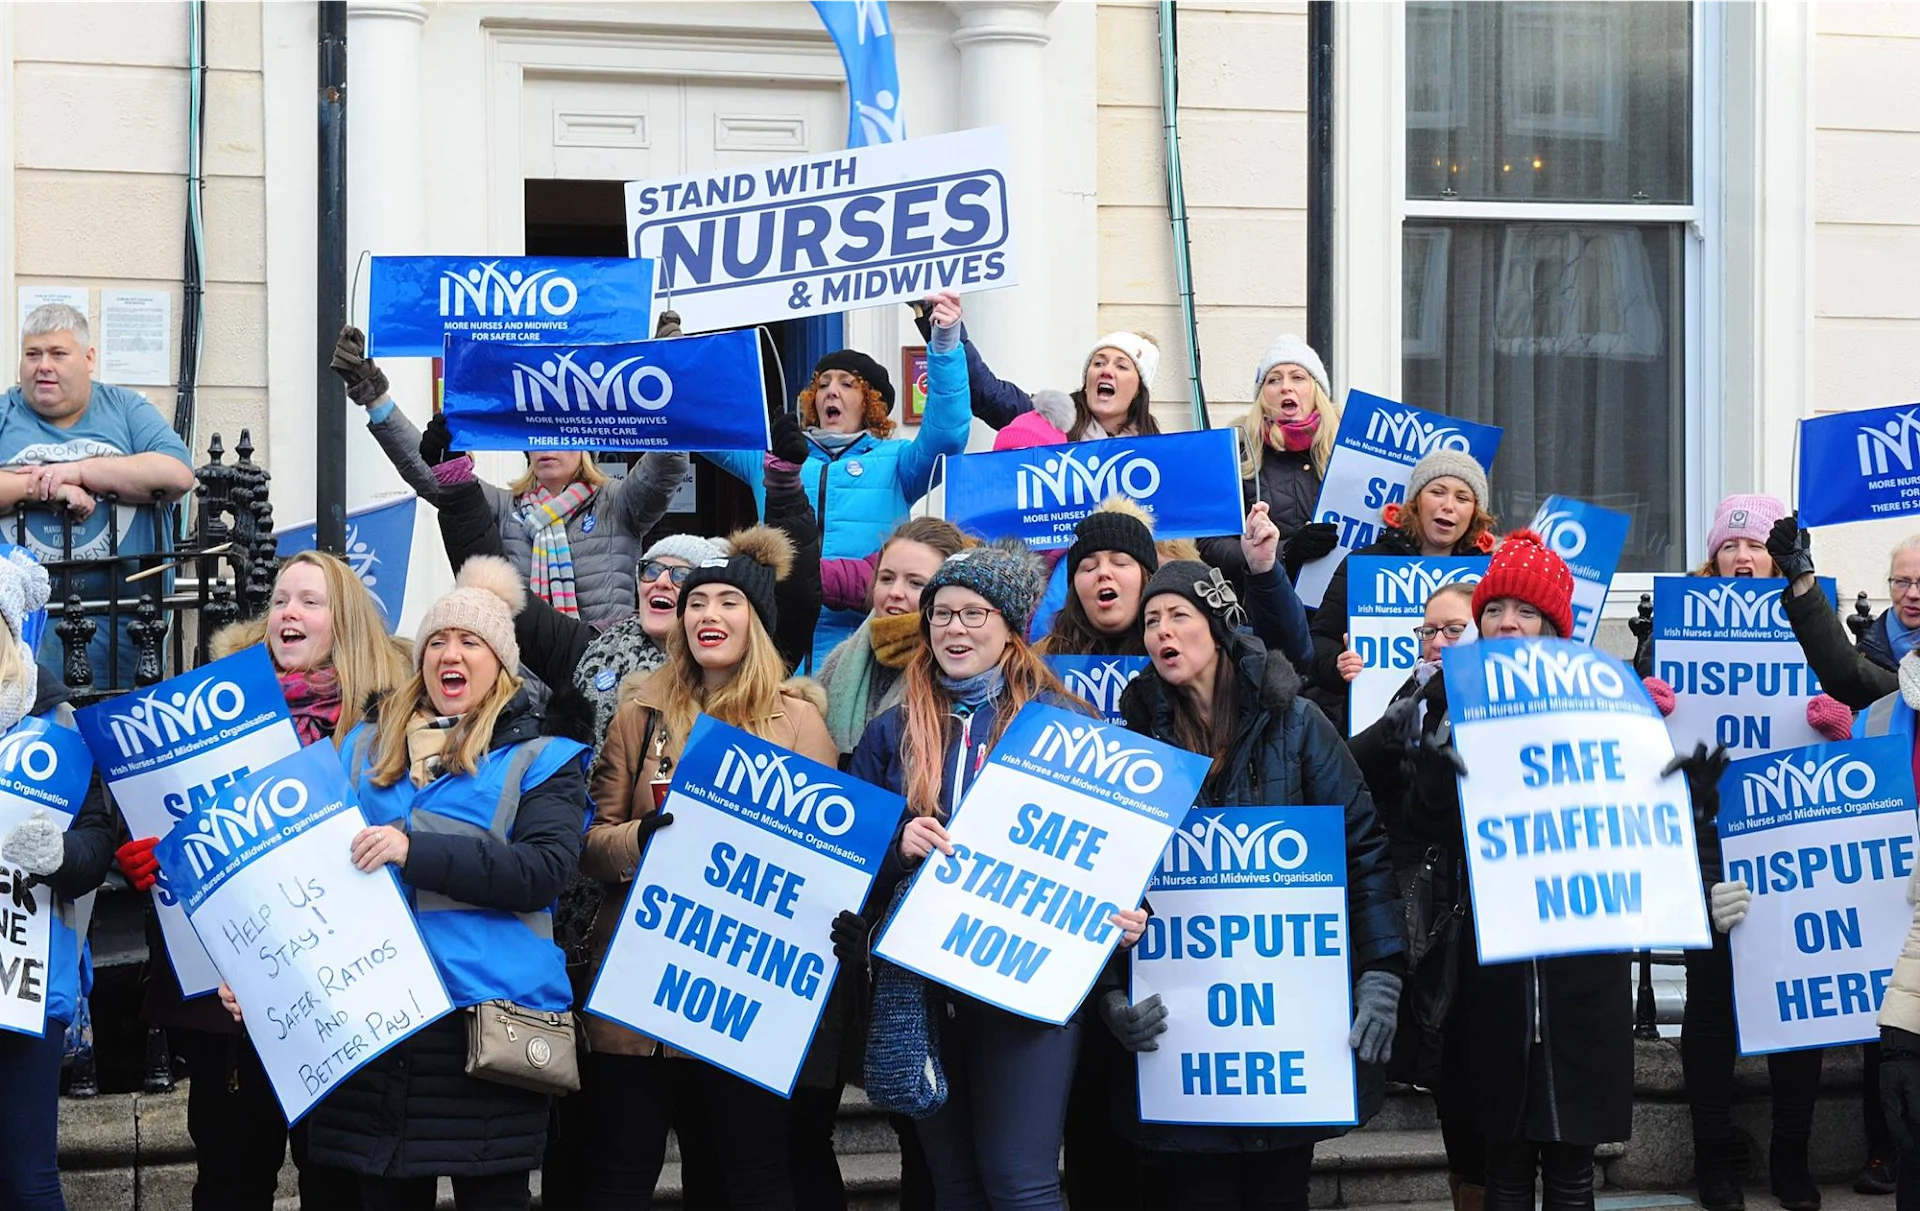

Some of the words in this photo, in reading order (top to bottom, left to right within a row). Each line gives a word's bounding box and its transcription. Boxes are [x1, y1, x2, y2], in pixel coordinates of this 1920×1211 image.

[638, 173, 756, 216] STAND
[766, 156, 857, 195] WITH
[659, 178, 991, 289] NURSES
[439, 260, 578, 316] INMO
[788, 280, 812, 310] &
[822, 251, 1005, 305] MIDWIVES
[524, 322, 568, 330] MIDWIVES
[511, 350, 673, 412] INMO
[525, 416, 553, 424] MORE
[555, 416, 593, 424] NURSES
[595, 416, 616, 425] AND
[617, 416, 668, 424] MIDWIVES
[528, 436, 559, 446] THERE
[561, 436, 570, 445] IS
[572, 436, 607, 446] SAFETY
[609, 437, 620, 446] IN
[621, 437, 669, 446] NUMBERS
[560, 426, 580, 434] FOR
[581, 427, 611, 435] SAFER
[612, 427, 638, 435] CARE
[1345, 437, 1361, 448] Irish
[1361, 441, 1387, 456] Nurses
[1388, 451, 1402, 460] and
[1366, 407, 1470, 455] INMO
[1016, 447, 1161, 510] INMO
[1869, 479, 1896, 491] MORE
[1871, 502, 1900, 513] THERE
[1902, 500, 1911, 510] IS
[1023, 513, 1049, 524] MORE
[1050, 510, 1085, 521] NURSES
[1024, 535, 1051, 546] THERE
[1053, 535, 1062, 543] IS
[1053, 523, 1071, 532] FOR
[1358, 604, 1373, 613] Irish
[1375, 605, 1402, 614] Nurses
[1404, 605, 1417, 614] and
[1376, 560, 1483, 604] INM
[1664, 628, 1680, 637] Irish
[1682, 629, 1712, 638] Nurses
[1713, 629, 1728, 638] and
[1730, 629, 1772, 639] Midwives
[1484, 640, 1624, 703] INMO
[110, 675, 245, 758] INMO
[110, 764, 128, 776] Irish
[128, 758, 155, 772] Nurses
[156, 750, 174, 763] and
[174, 734, 219, 758] Midwives
[219, 710, 277, 739] Organisation
[1716, 715, 1771, 749] ON
[1030, 720, 1163, 794] INMO
[1519, 739, 1625, 788] SAFE
[1742, 753, 1876, 816] INMO
[13, 780, 69, 807] Organisation
[714, 743, 855, 836] INMO
[1001, 753, 1020, 767] Irish
[1021, 760, 1052, 776] Nurses
[1053, 771, 1070, 783] and
[1071, 777, 1110, 798] Midwives
[1112, 791, 1169, 820] Organisation
[183, 775, 308, 880] INMO
[684, 781, 706, 797] Irish
[707, 791, 739, 812] Nurses
[741, 807, 759, 820] and
[760, 814, 803, 839] Midwives
[805, 833, 867, 866] Organisation
[1008, 803, 1108, 871] SAFE
[1162, 813, 1308, 872] INMO
[1477, 802, 1683, 861] STAFFING
[1728, 822, 1745, 832] Irish
[1746, 815, 1775, 829] Nurses
[1776, 812, 1792, 824] and
[1794, 806, 1842, 820] Midwives
[1844, 798, 1903, 815] Organisation
[201, 869, 226, 893] Nurses
[225, 857, 241, 873] and
[240, 834, 283, 862] Midwives
[283, 800, 343, 837] Organisation
[1728, 835, 1914, 896] DISPUTE
[704, 841, 806, 919] SAFE
[935, 844, 1120, 944] STAFFING
[1162, 875, 1197, 886] Nurses
[1199, 874, 1218, 884] and
[1220, 872, 1271, 884] Midwives
[1272, 872, 1333, 886] Organisation
[1535, 870, 1642, 924] NOW
[221, 904, 271, 954] HELP
[634, 884, 825, 1001] STAFFING
[941, 912, 1051, 983] NOW
[1138, 913, 1341, 960] DISPUTE
[1794, 907, 1862, 954] ON
[267, 990, 321, 1040] SAFER
[317, 939, 397, 997] RATIOS
[653, 963, 762, 1042] NOW
[1207, 983, 1275, 1028] ON
[315, 1009, 349, 1044] AND
[299, 1034, 369, 1096] BETTER
[1180, 1051, 1307, 1096] HERE
